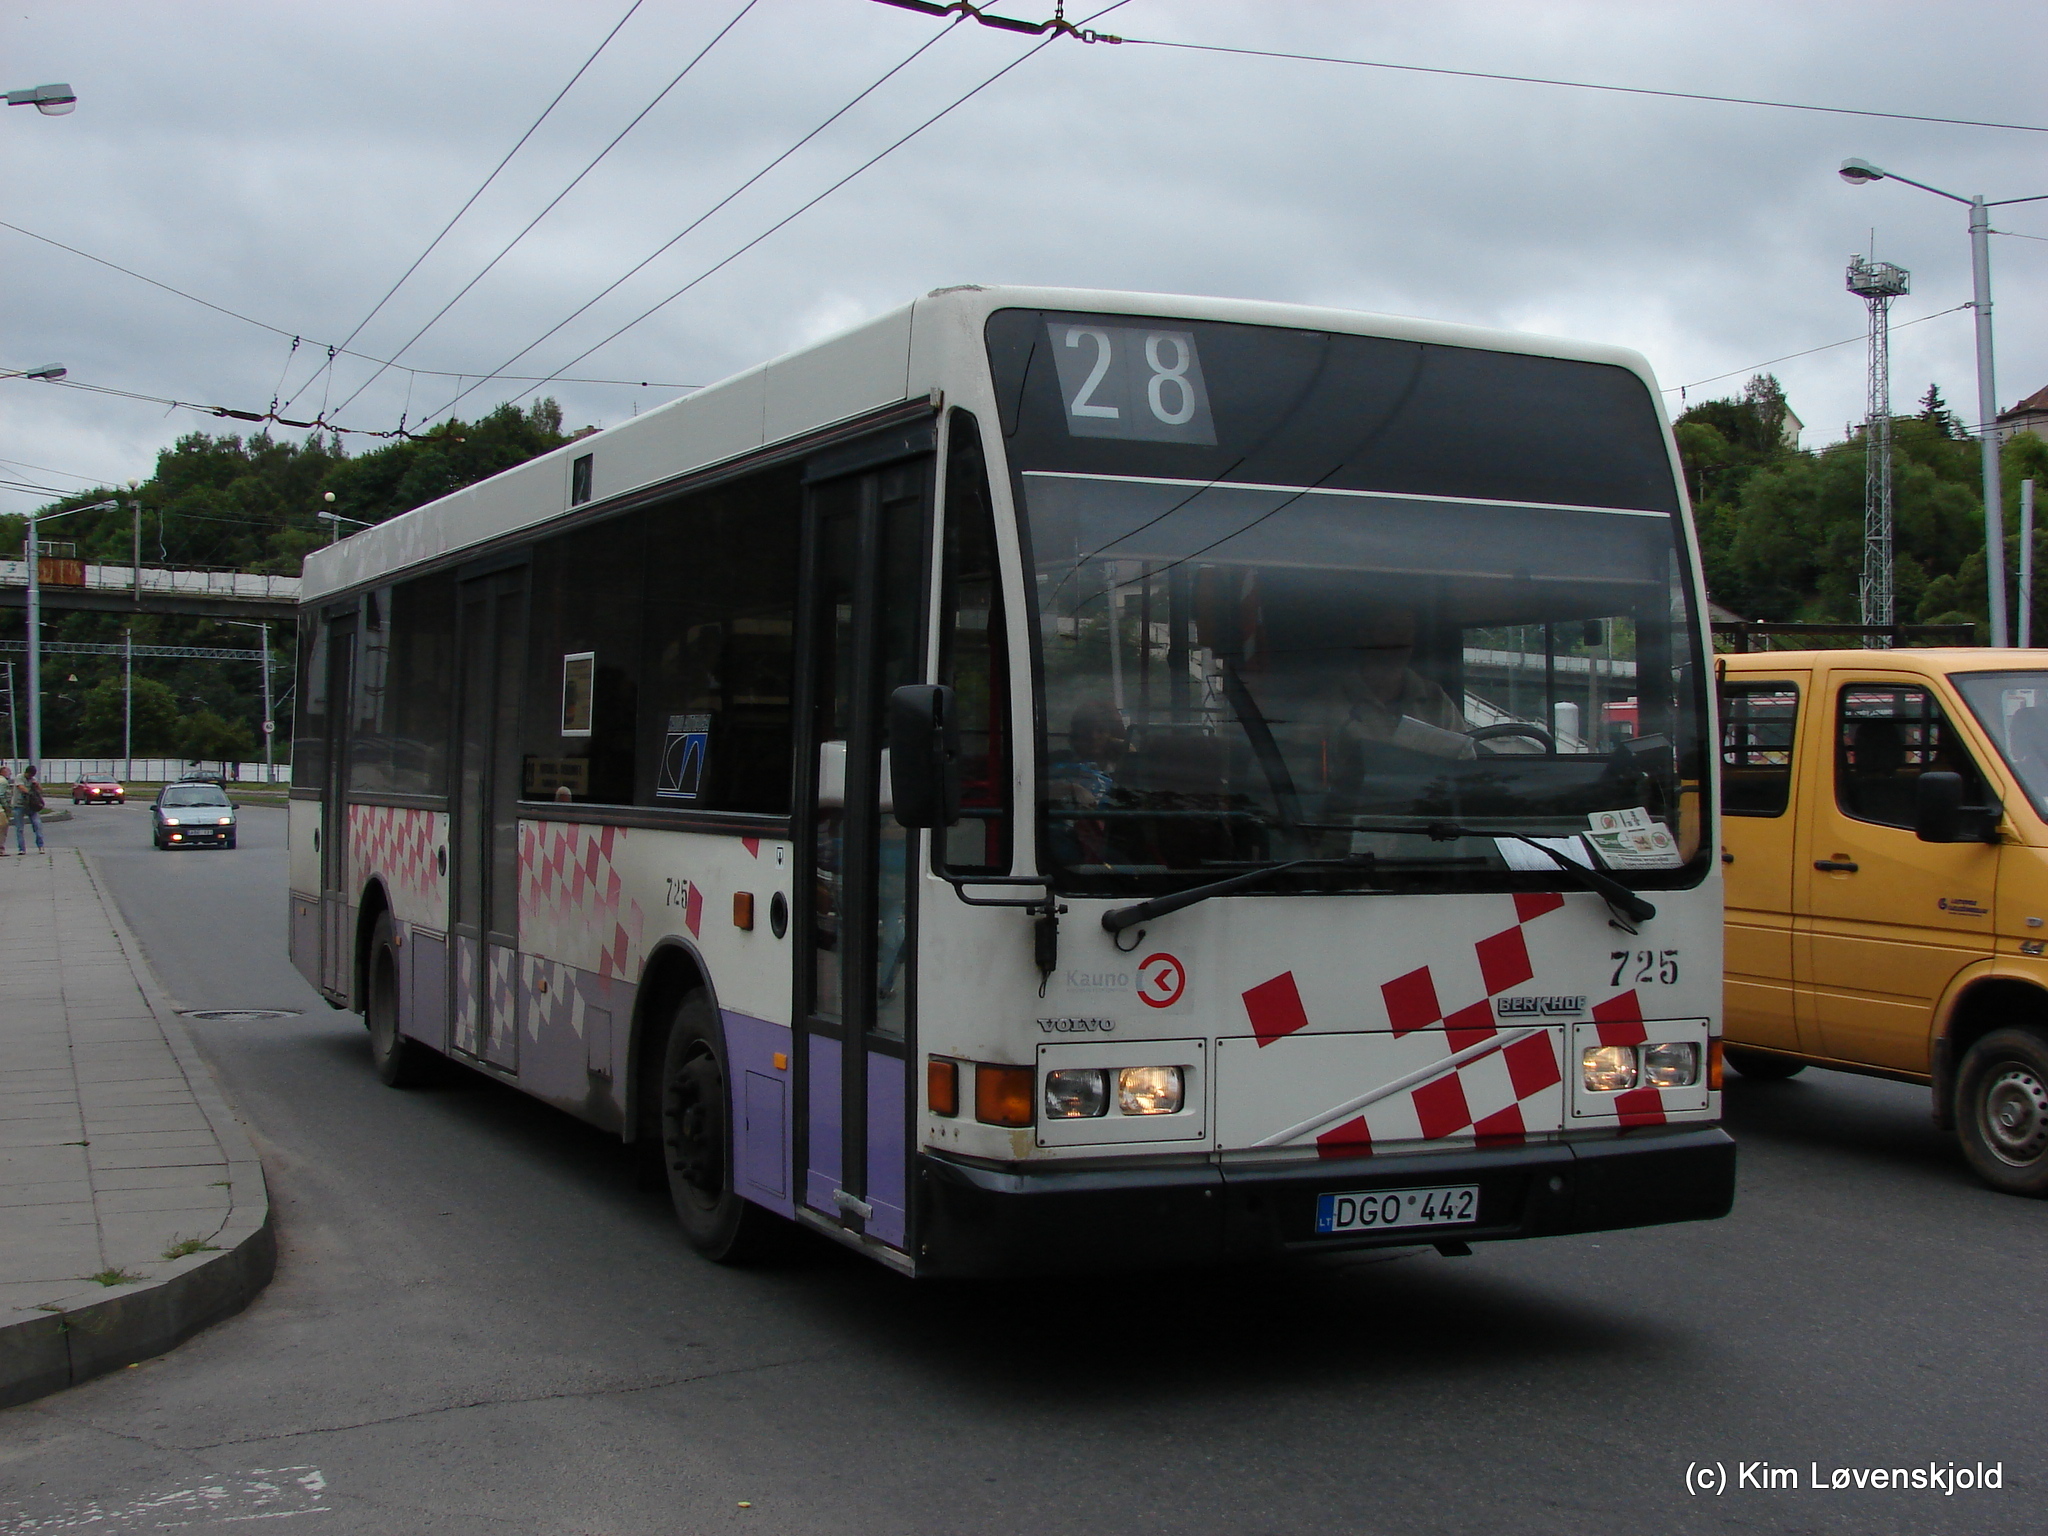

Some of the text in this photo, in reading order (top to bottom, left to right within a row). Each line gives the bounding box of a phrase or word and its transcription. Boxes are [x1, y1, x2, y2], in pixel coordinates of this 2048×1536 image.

[1065, 328, 1196, 425] 28
[666, 877, 688, 910] 725
[1066, 969, 1130, 988] Kauno
[1610, 949, 1679, 987] 725
[1498, 995, 1588, 1017] BERKHOF
[1037, 1017, 1117, 1033] VOLVO
[1318, 1217, 1333, 1227] LT
[1336, 1190, 1474, 1228] DGO 442
